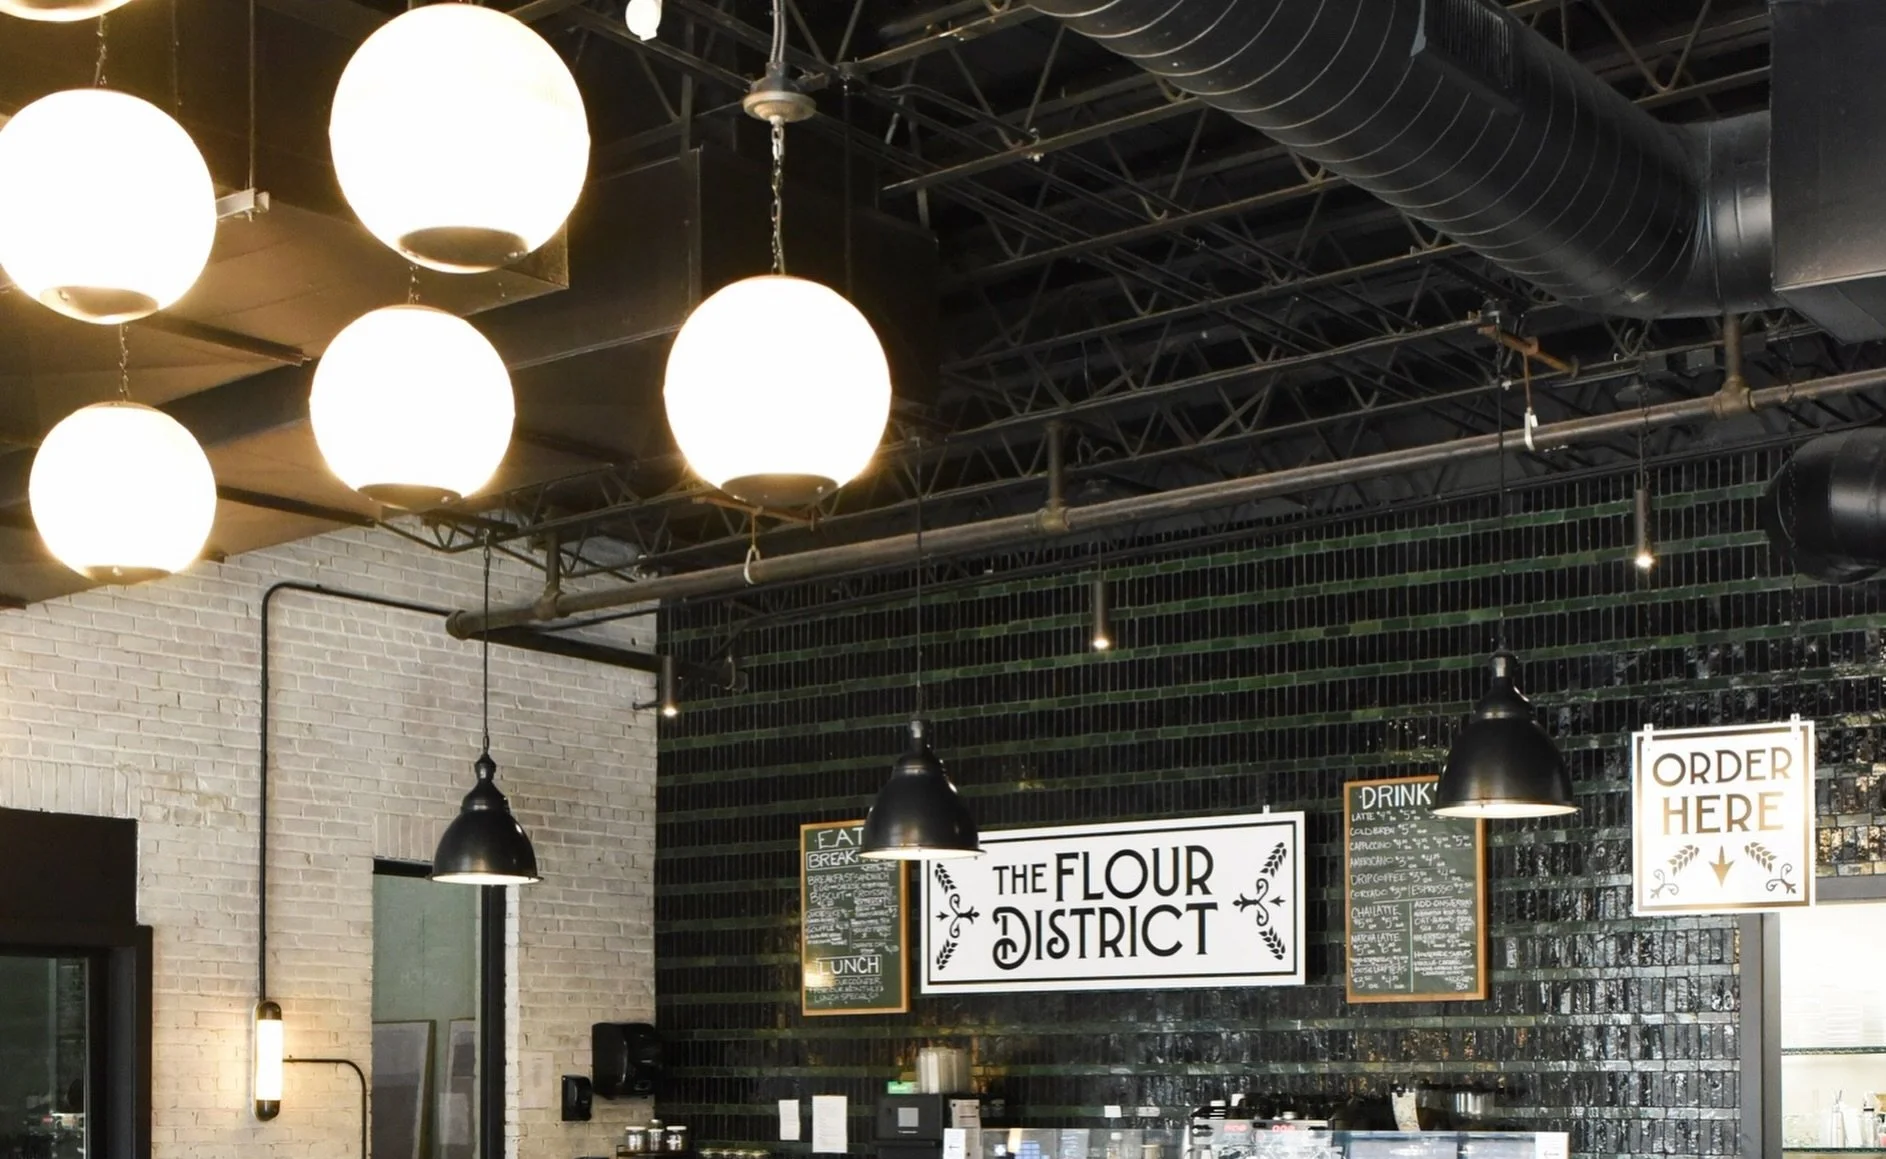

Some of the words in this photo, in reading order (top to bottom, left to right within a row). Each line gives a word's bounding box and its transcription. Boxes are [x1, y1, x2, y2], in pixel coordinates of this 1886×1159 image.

[1653, 747, 1792, 787] ORDER
[1361, 783, 1438, 809] DRINK
[1352, 811, 1375, 822] LATTE
[1663, 792, 1784, 835] HERE
[817, 827, 864, 849] EAT
[993, 863, 1047, 894] THE
[1055, 844, 1215, 901] FLOUR
[993, 901, 1219, 970] DISTRICT
[818, 956, 880, 976] LUNCH
